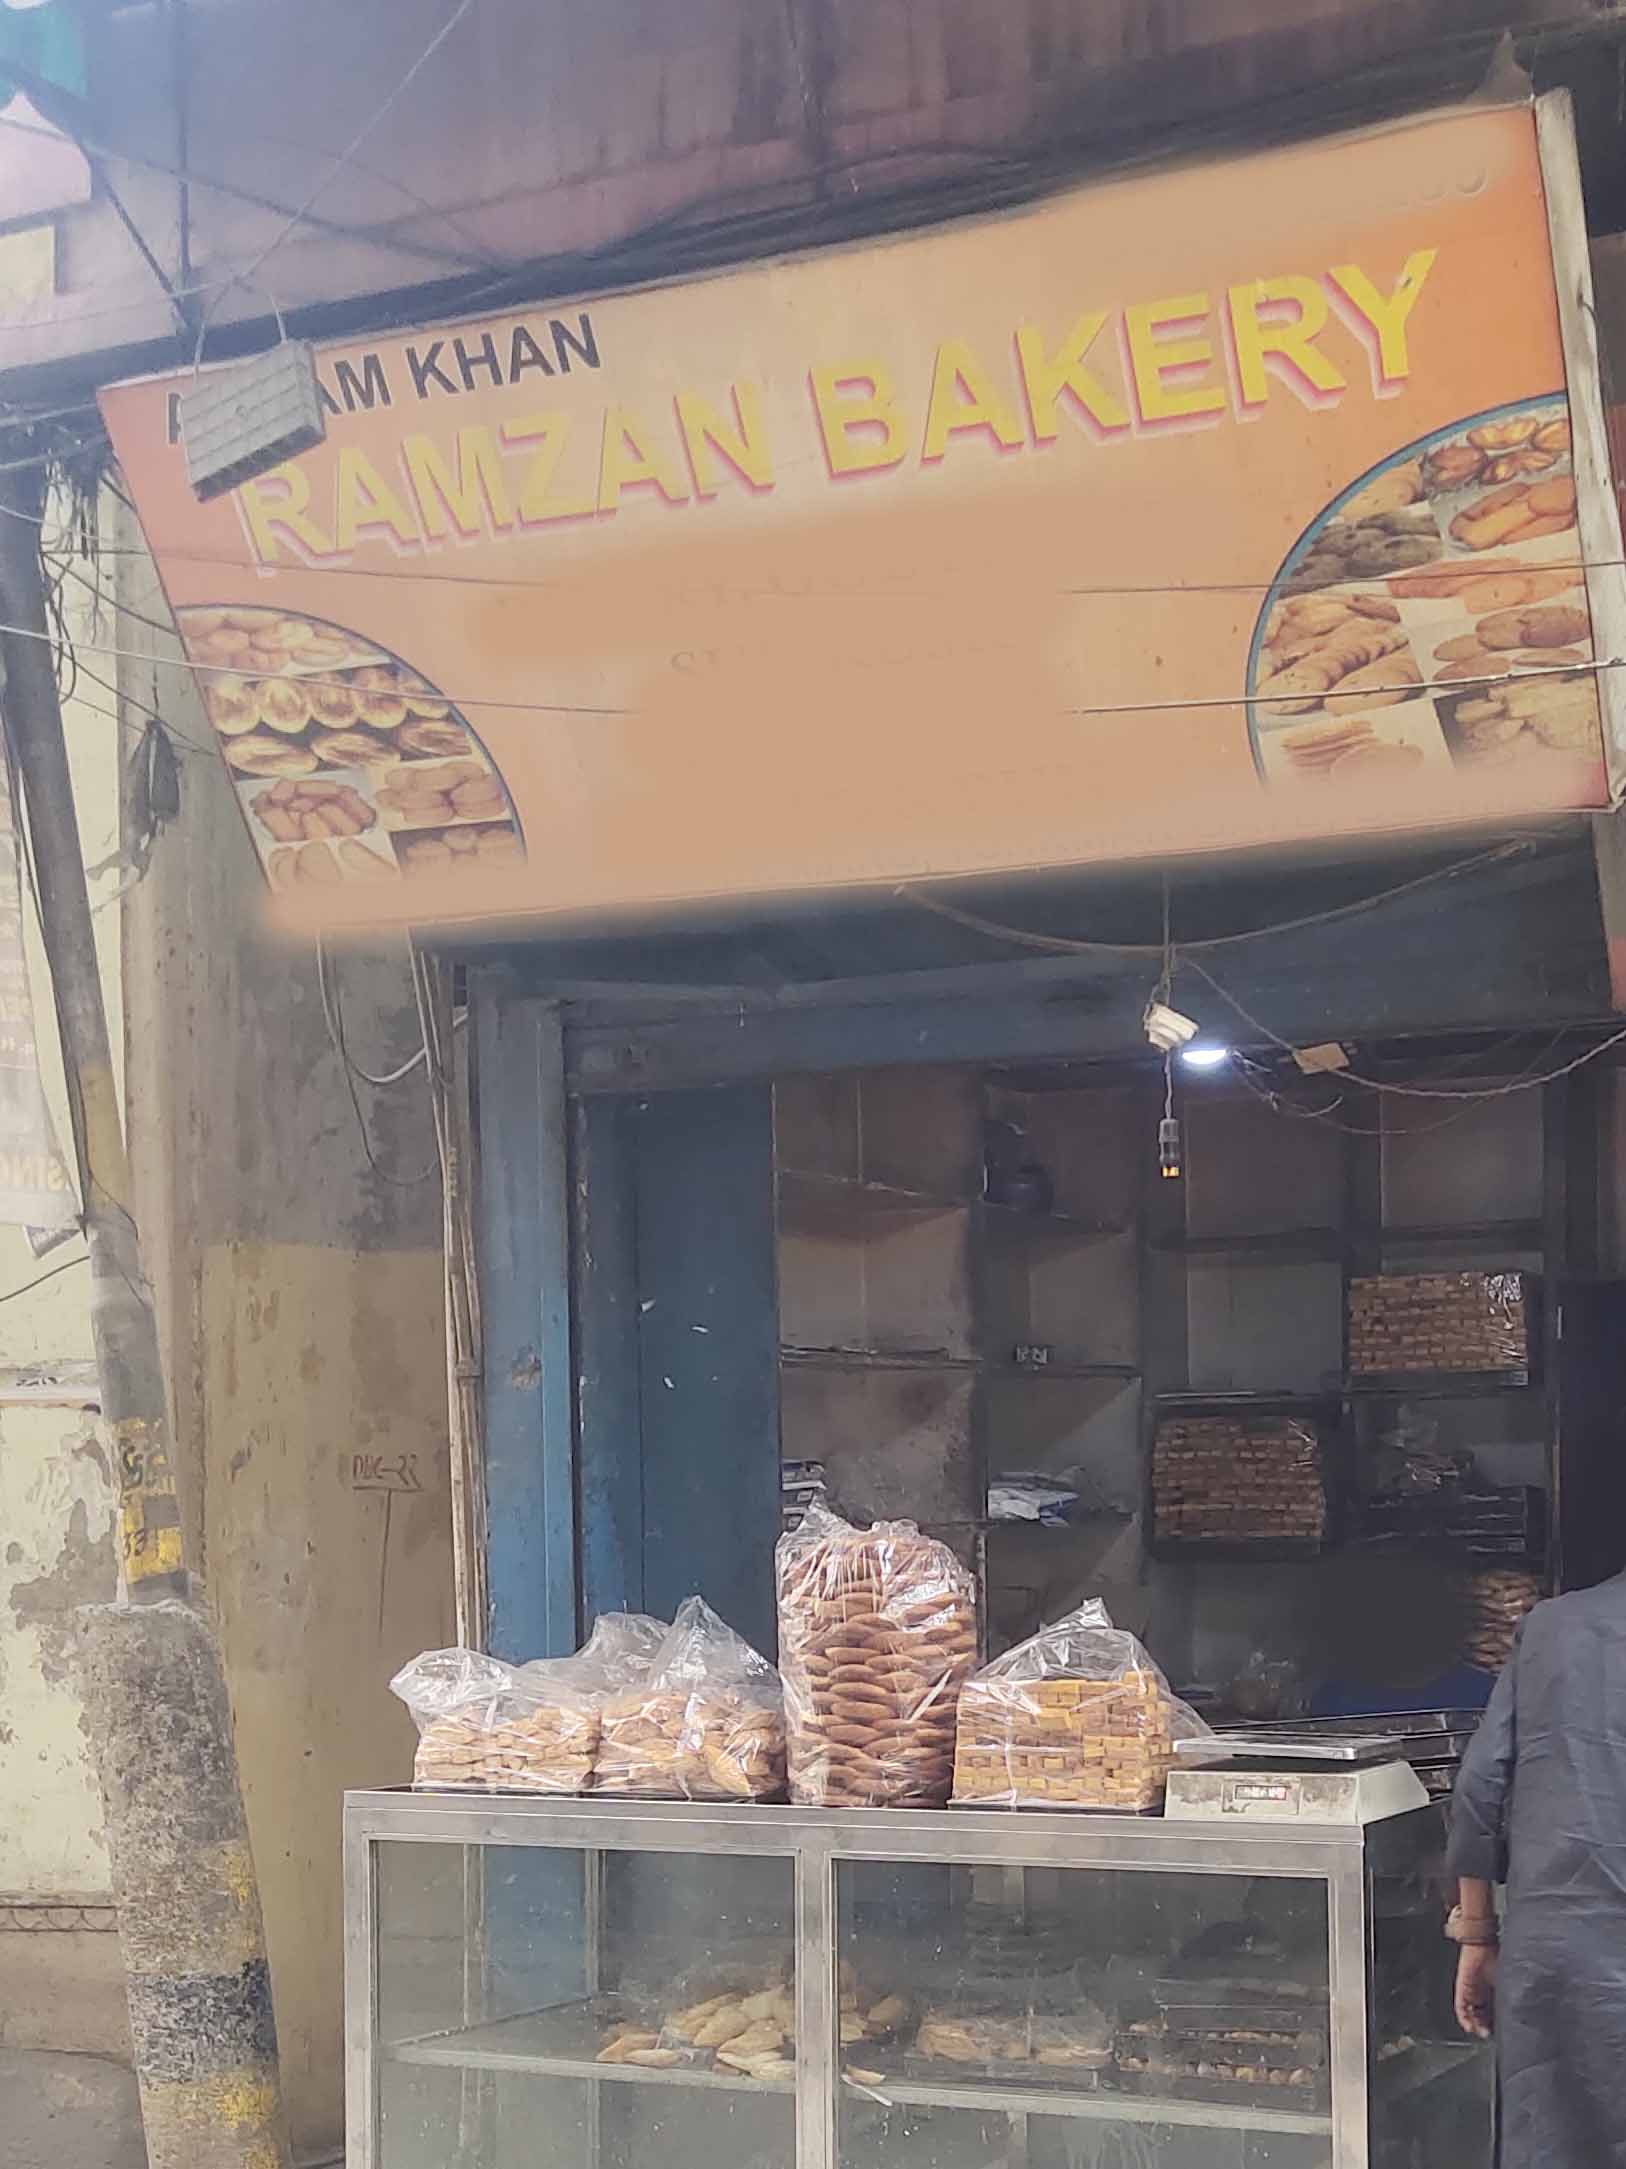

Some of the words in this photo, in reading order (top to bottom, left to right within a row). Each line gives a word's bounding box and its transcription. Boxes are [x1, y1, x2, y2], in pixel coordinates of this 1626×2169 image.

[234, 382, 776, 577] RAMZAN
[808, 248, 1439, 482] BAKERY
[405, 312, 601, 401] KHAN
